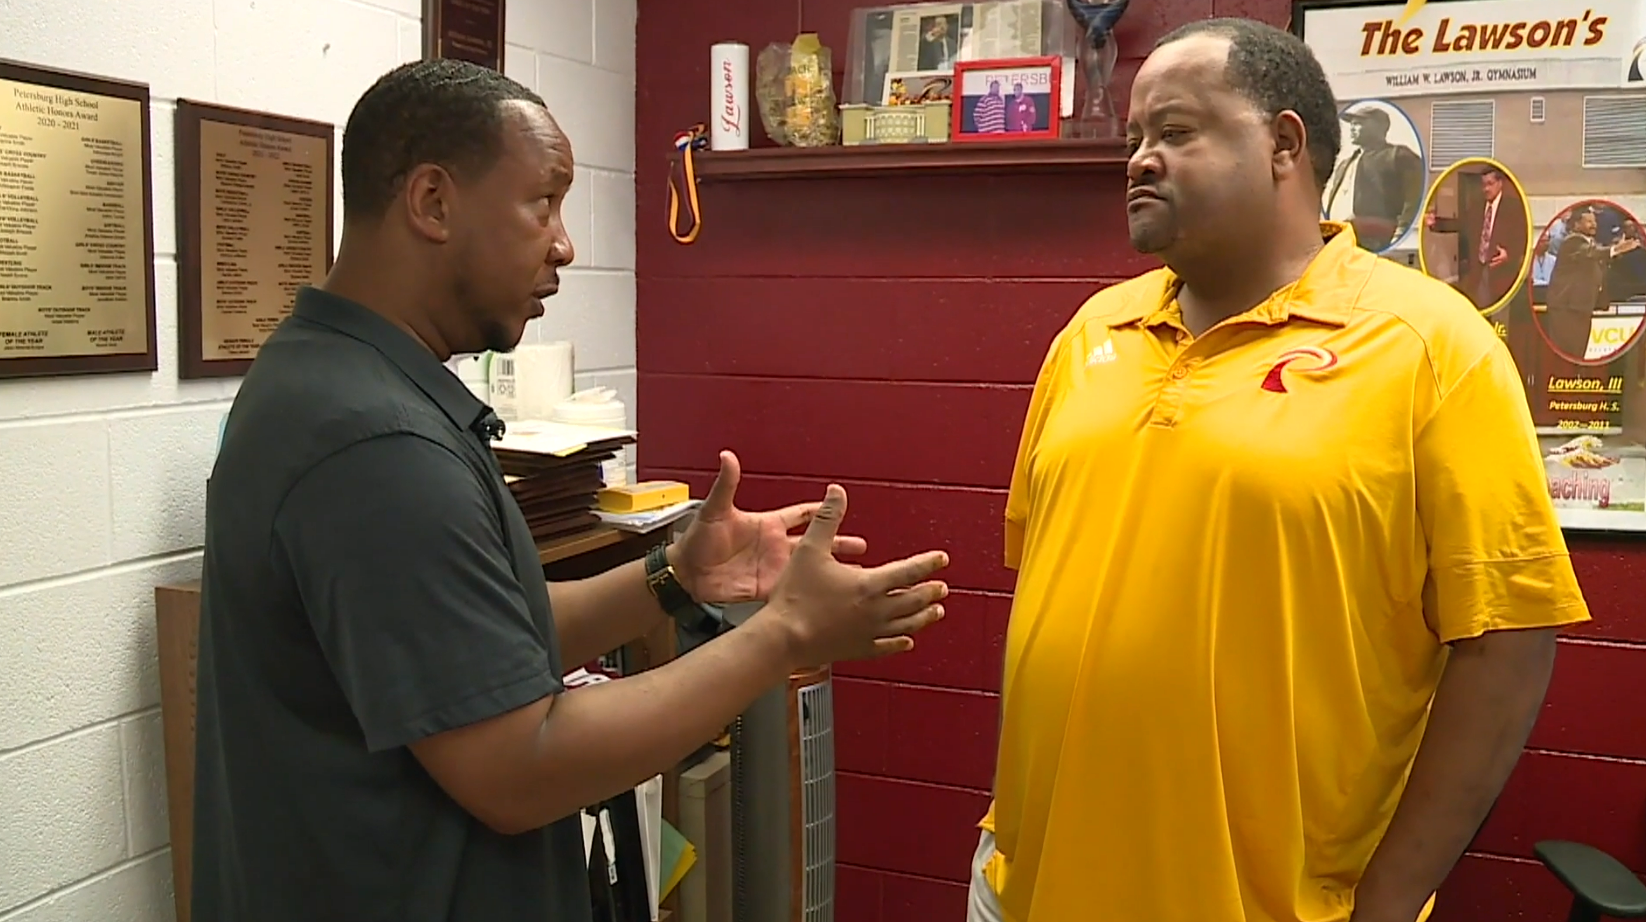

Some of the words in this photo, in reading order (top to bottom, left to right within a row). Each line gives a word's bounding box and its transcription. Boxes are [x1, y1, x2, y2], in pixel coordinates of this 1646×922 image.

[1361, 20, 1424, 56] The
[1432, 10, 1608, 53] Lawson's
[1386, 74, 1419, 86] WILLIAM
[1434, 70, 1469, 84] LAWSON,
[1486, 68, 1537, 82] GYMNASIUM
[14, 88, 54, 104] Petersburg
[55, 94, 74, 106] High
[74, 98, 99, 110] School
[720, 57, 741, 138] Lawson
[16, 102, 45, 114] Athletic
[48, 104, 74, 118] Honors
[75, 110, 98, 122] Award
[38, 116, 56, 128] 2020
[63, 121, 80, 130] 2021
[1548, 376, 1604, 391] Lawson,
[1608, 377, 1622, 391] III
[1549, 401, 1598, 412] Petersburg
[1599, 401, 1609, 411] H.
[1611, 402, 1620, 411] S.
[1549, 471, 1611, 508] aching
